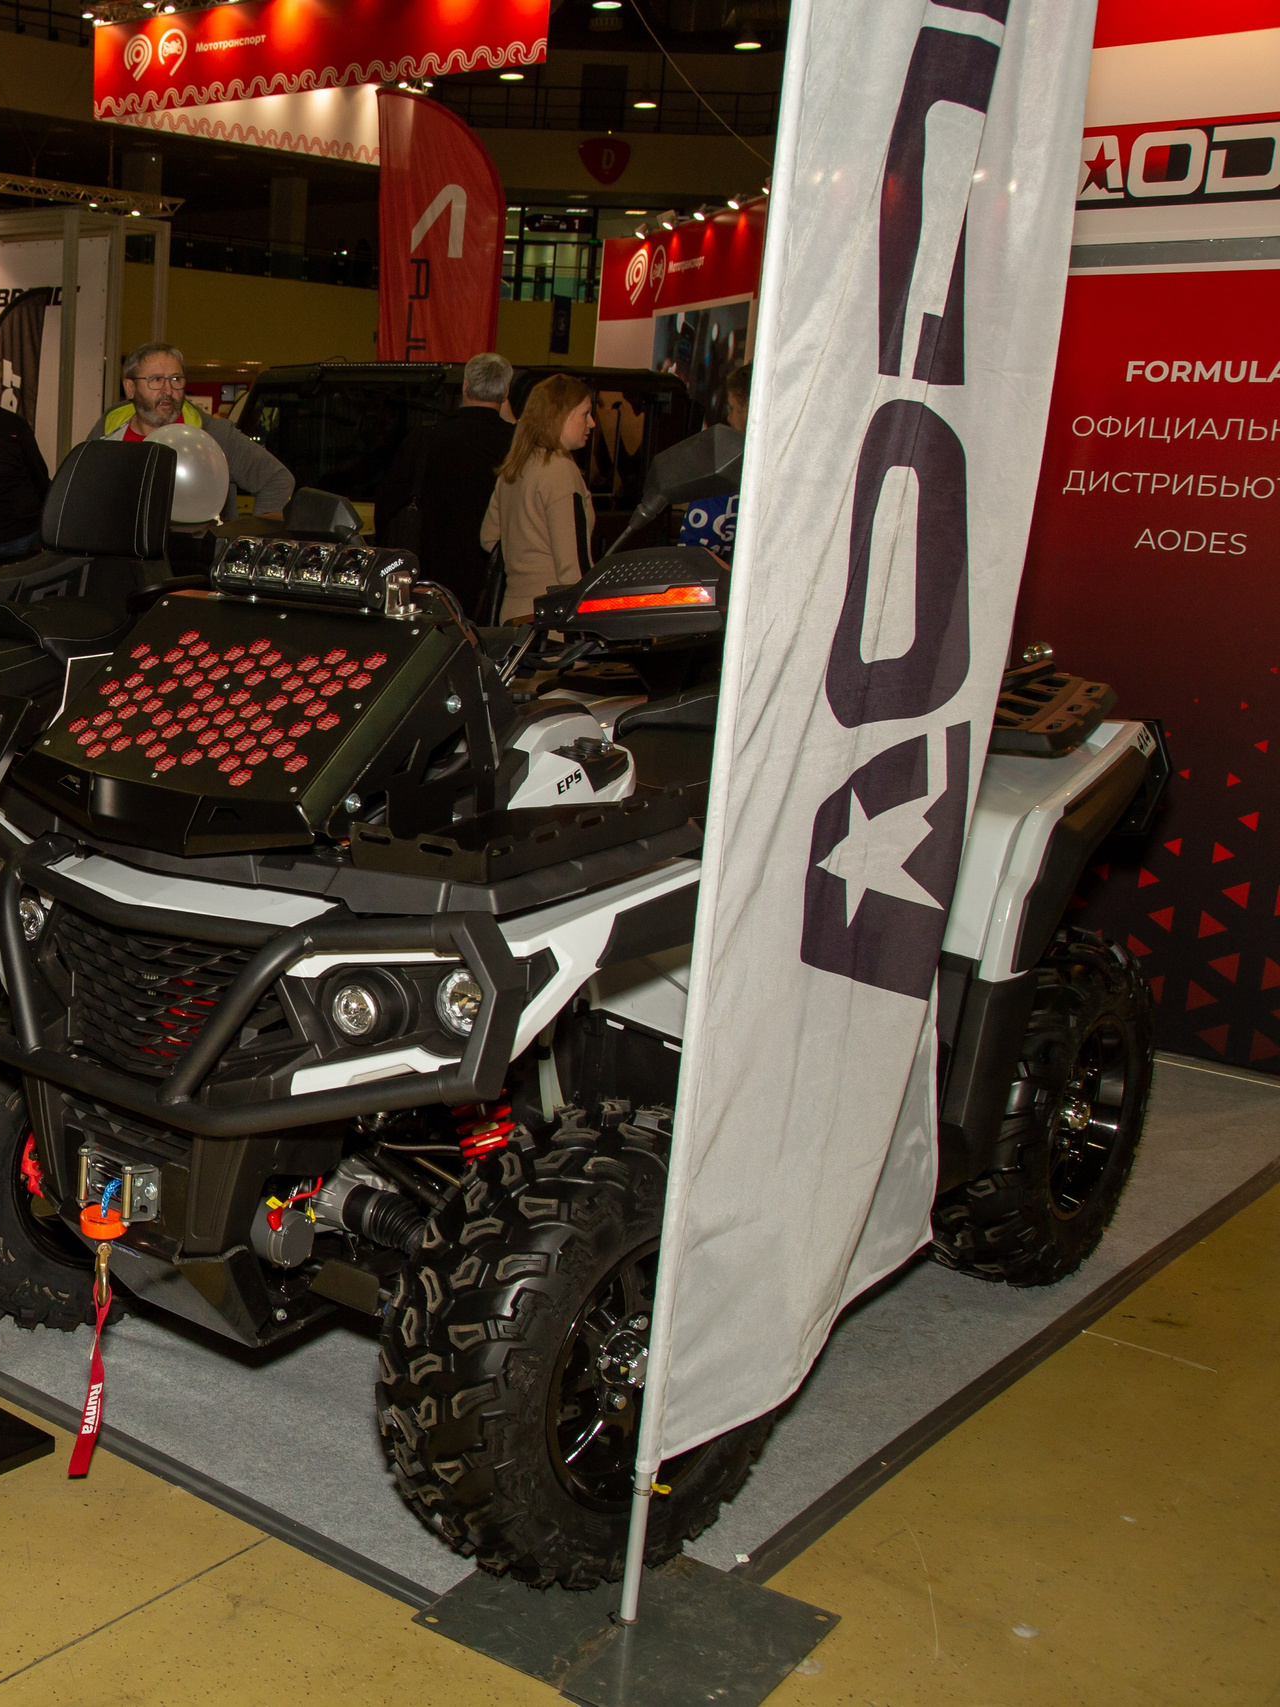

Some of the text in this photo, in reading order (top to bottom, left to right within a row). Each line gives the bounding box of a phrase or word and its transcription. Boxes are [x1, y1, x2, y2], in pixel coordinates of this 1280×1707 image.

[195, 34, 267, 52] Мототранспорт
[1062, 470, 1280, 499] ДИСТРИБЬЮ
[1134, 528, 1248, 555] AODES
[379, 558, 404, 577] AURORA
[556, 768, 582, 795] EPS
[81, 1382, 103, 1435] Runva
